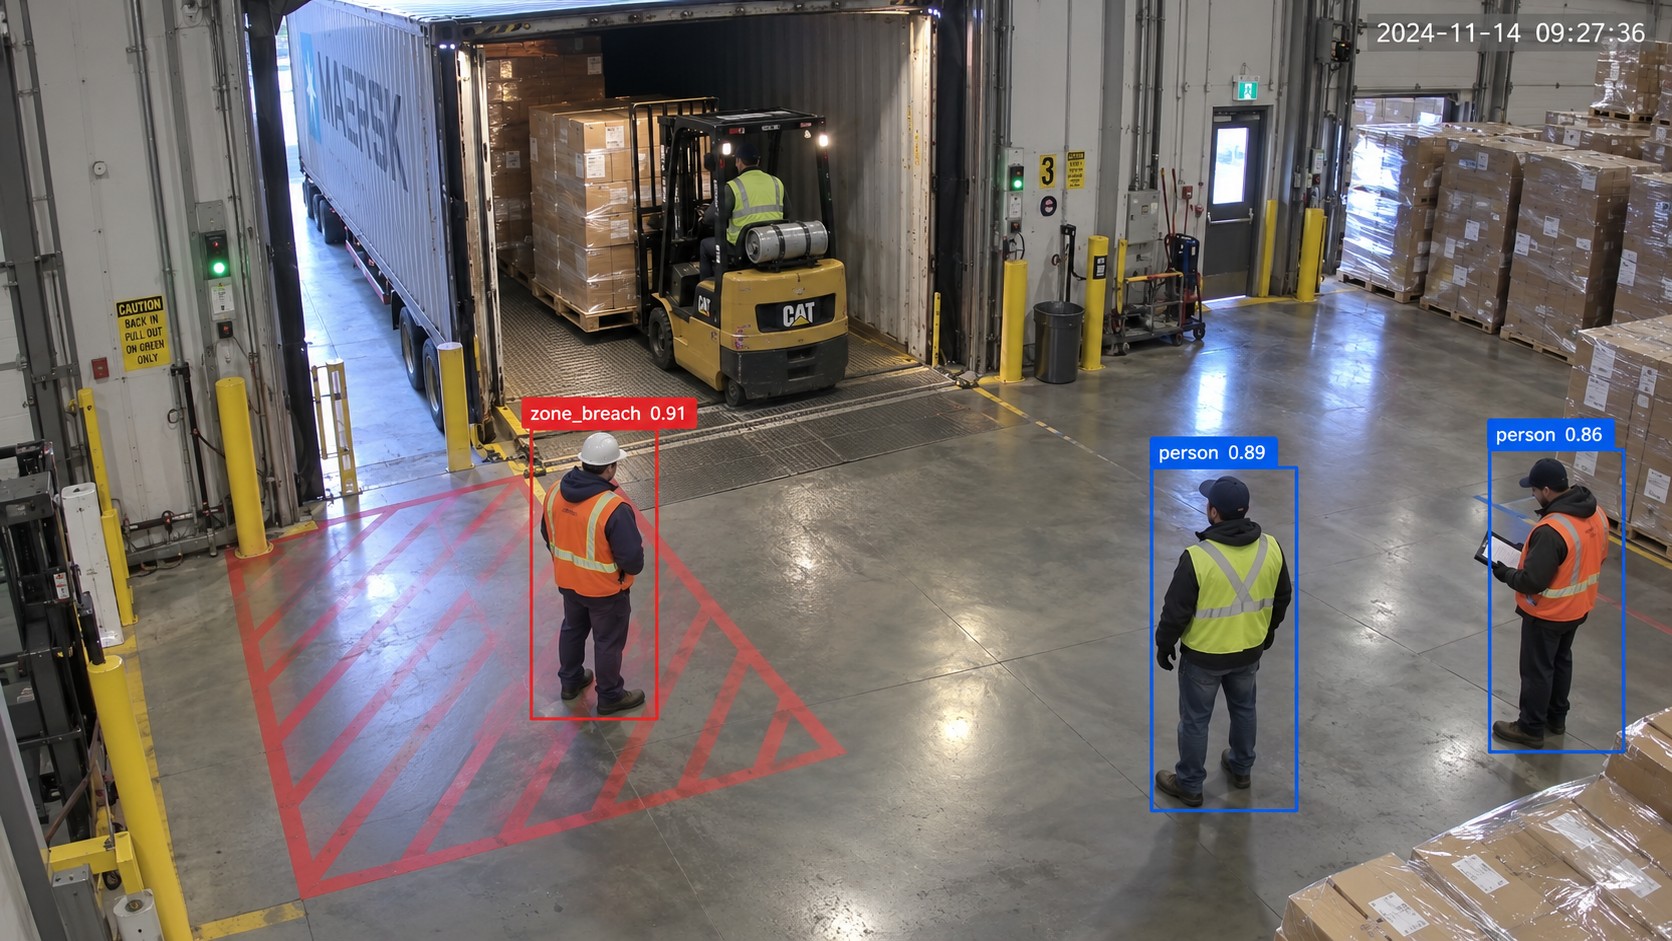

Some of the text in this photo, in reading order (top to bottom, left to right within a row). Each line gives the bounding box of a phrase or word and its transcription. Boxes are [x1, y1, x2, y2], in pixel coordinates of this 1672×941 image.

[318, 51, 409, 192] MAERSK
[1041, 157, 1054, 186] 3
[118, 299, 162, 316] CAUTION
[698, 295, 711, 314] CAT
[125, 314, 159, 329] BACK IN
[783, 301, 815, 328] CAT
[125, 327, 163, 341] PULL OUT
[126, 340, 165, 354] ON GREEN
[137, 353, 158, 365] ONLY
